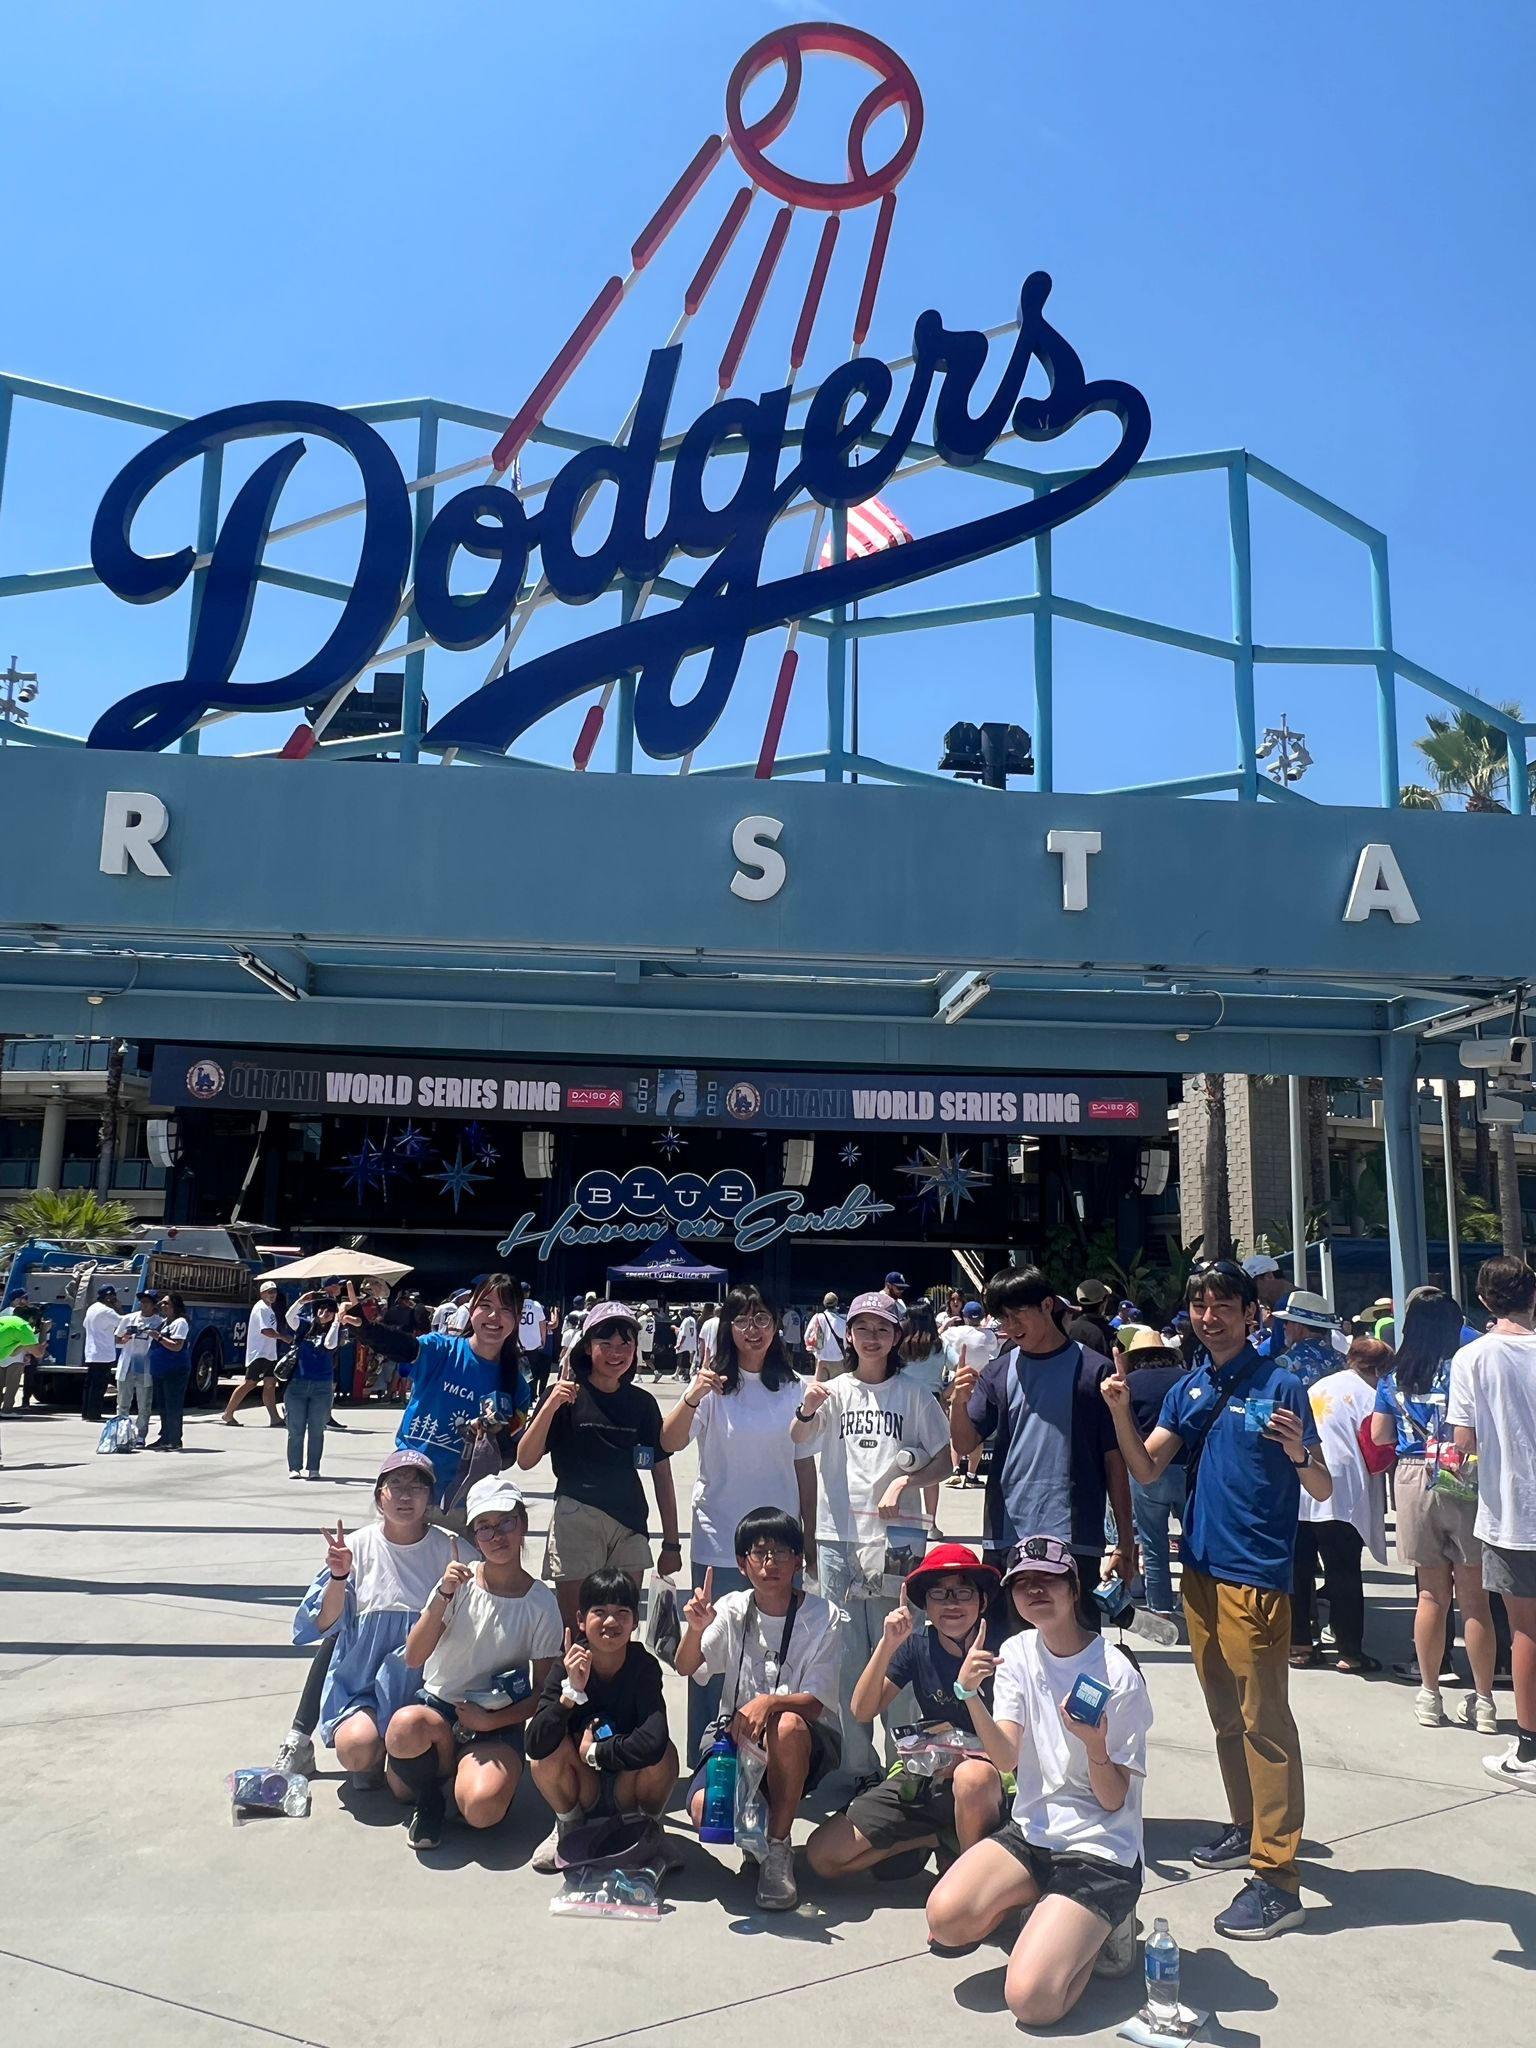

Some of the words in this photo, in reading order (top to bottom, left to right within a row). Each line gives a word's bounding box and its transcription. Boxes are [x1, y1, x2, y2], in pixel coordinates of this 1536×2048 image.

[87, 270, 1152, 760] Dodgers
[229, 1067, 321, 1101] OHTANI
[326, 1072, 413, 1106] WORLD
[418, 1076, 498, 1110] SERIES
[503, 1080, 561, 1112] RING
[764, 1088, 847, 1119] OHTANI
[852, 1089, 935, 1121] WORLD
[940, 1091, 1017, 1122] SERIES
[1023, 1093, 1080, 1123] RING
[588, 1182, 743, 1207] BLUE
[497, 1203, 668, 1262] Heaven
[676, 1217, 725, 1239] on
[733, 1183, 895, 1252] Earth
[443, 1380, 475, 1401] YMCA
[839, 1409, 904, 1441] PRESTON
